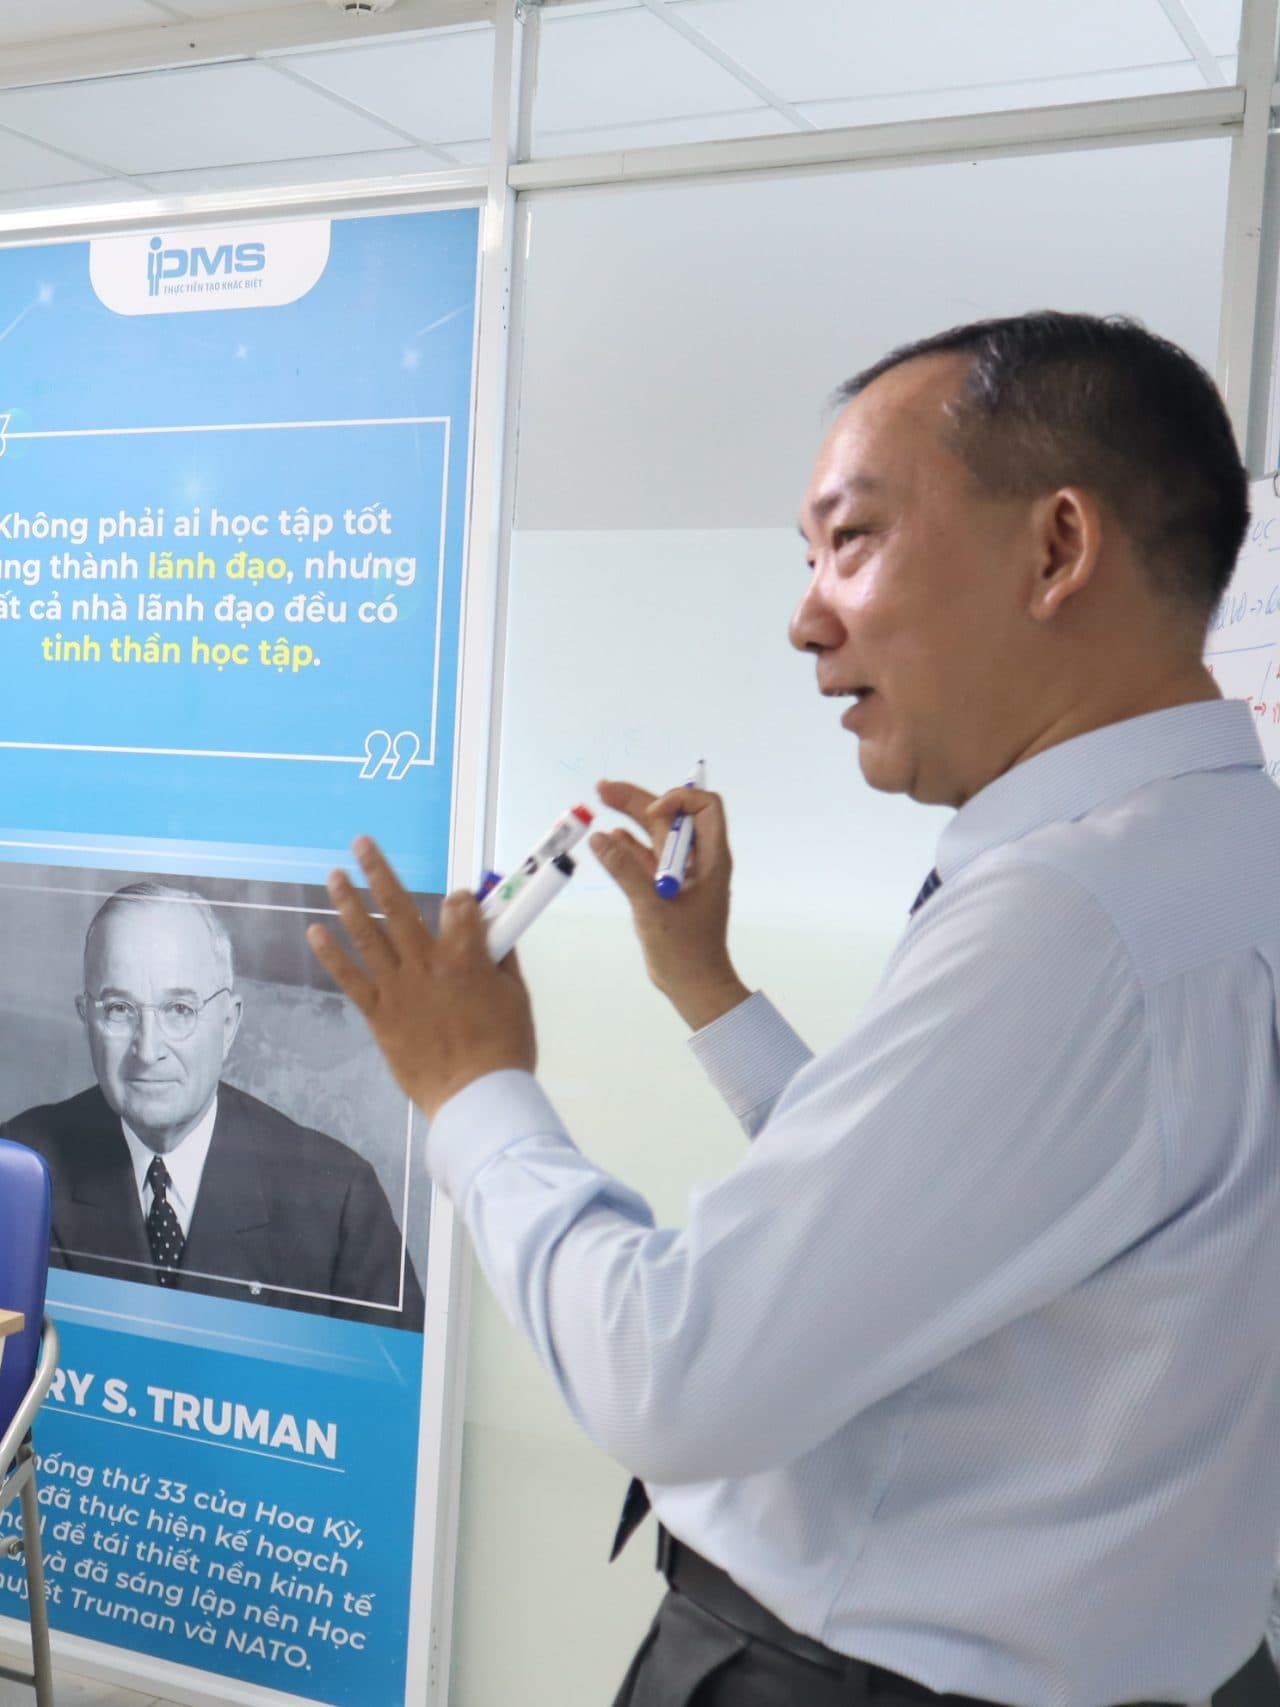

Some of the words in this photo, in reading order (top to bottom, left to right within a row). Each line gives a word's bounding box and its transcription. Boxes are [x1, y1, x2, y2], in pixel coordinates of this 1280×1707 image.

[98, 507, 165, 544] phải
[174, 507, 200, 537] ai
[210, 508, 269, 544] học
[278, 506, 334, 542] tập
[344, 502, 392, 535] tốt
[29, 590, 63, 620] cả
[72, 593, 127, 621] nhà
[138, 593, 204, 622] lãnh
[214, 593, 274, 629] đạo
[284, 590, 347, 624] đều
[358, 593, 399, 624] có
[50, 552, 139, 580] thành
[149, 551, 216, 580] lãnh
[226, 551, 294, 587] đạo,
[305, 550, 417, 586] nhưng
[42, 632, 101, 662] tinh
[110, 632, 181, 664] thần
[192, 636, 249, 672] học
[259, 637, 320, 673] tập.
[45, 1368, 95, 1406] RY
[102, 1378, 137, 1418] S.
[147, 1385, 337, 1460] TRUMAN
[38, 1485, 71, 1510] đã
[79, 1496, 140, 1526] thực
[146, 1508, 207, 1542] hiện
[215, 1525, 252, 1552] kế
[256, 1534, 348, 1577] hoạch
[102, 1467, 151, 1496] thứ
[154, 1478, 189, 1504] 33
[194, 1488, 247, 1519] của
[255, 1501, 315, 1535] Hoa
[323, 1516, 364, 1550] Kỳ,
[53, 1522, 87, 1545] để
[93, 1530, 130, 1556] tái
[136, 1541, 200, 1575] thiết
[207, 1561, 261, 1590] nền
[270, 1572, 334, 1608] kinh
[343, 1592, 376, 1617] tế
[74, 1558, 109, 1584] đã
[115, 1571, 184, 1608] sáng
[191, 1585, 237, 1619] lập
[244, 1604, 299, 1633] nên
[308, 1616, 367, 1651] Học
[71, 1587, 175, 1634] Truman
[184, 1621, 217, 1646] và
[225, 1629, 311, 1671] NATO.
